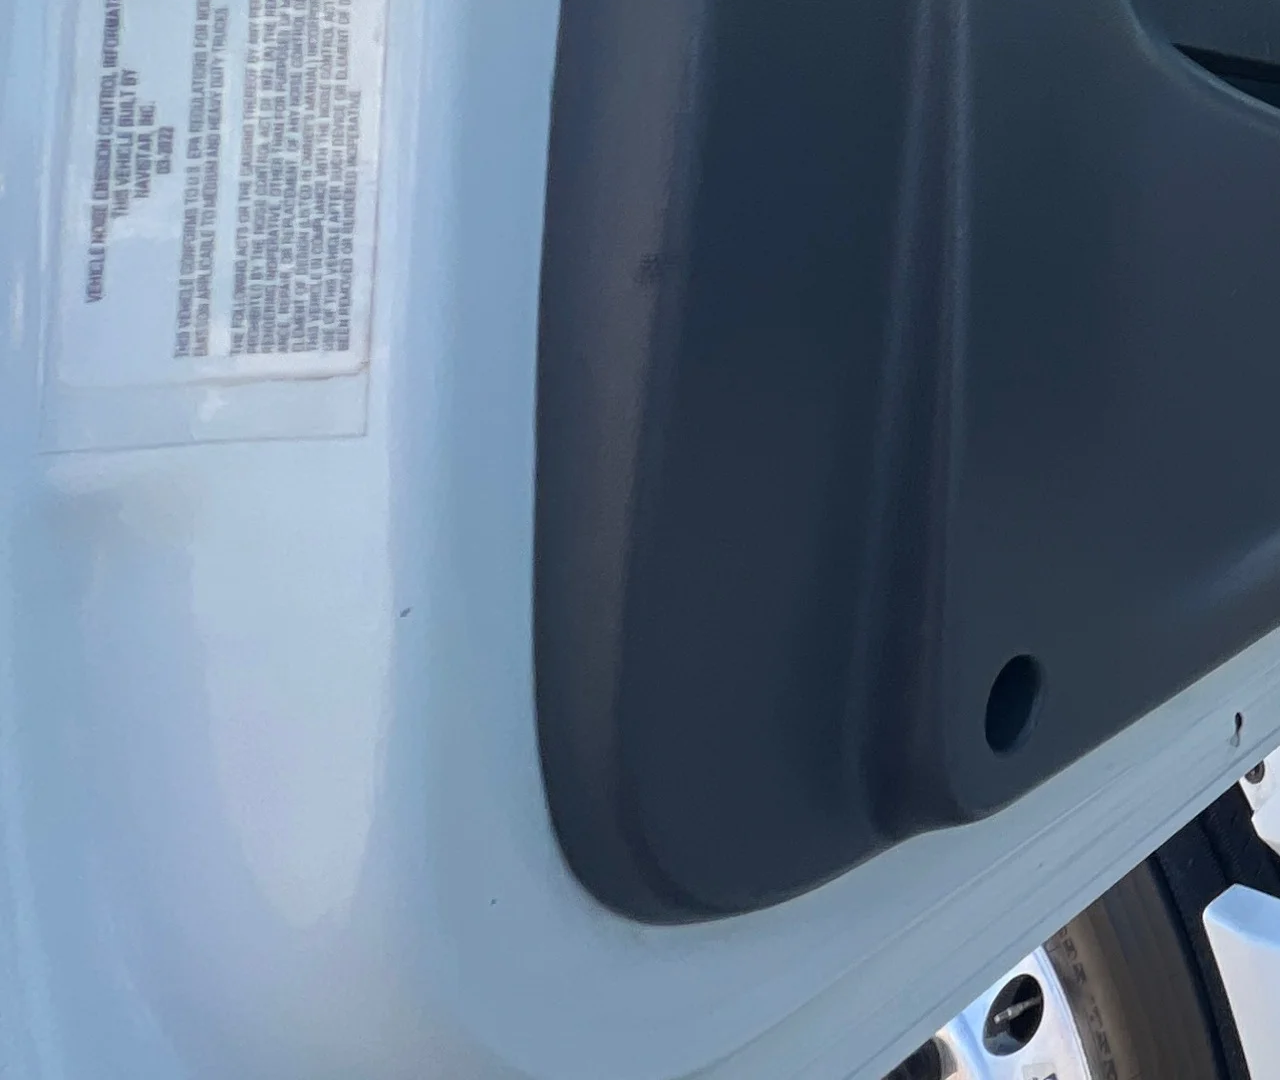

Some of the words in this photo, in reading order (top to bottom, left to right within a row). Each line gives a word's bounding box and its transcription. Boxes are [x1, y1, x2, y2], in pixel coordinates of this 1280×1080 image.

[193, 24, 209, 48] FOR
[120, 69, 139, 86] BY
[187, 52, 207, 132] REGULATIONS
[210, 58, 226, 88] DUTY
[96, 72, 117, 135] CONTROL
[117, 90, 136, 127] BUILT
[206, 91, 223, 130] HEAVY
[92, 139, 111, 200] EMISSION
[112, 131, 133, 186] VEHICLE
[110, 190, 129, 219] THIS
[201, 161, 217, 207] MEDIUM
[88, 206, 108, 244] NOISE
[179, 208, 197, 276] CONFORMS
[235, 228, 249, 256] ACTS
[86, 248, 105, 304] VEHICLE
[195, 229, 215, 299] APPLICABLE
[176, 279, 193, 329] VEHICLE
[231, 260, 247, 328] FOLLOWING
[174, 332, 190, 358] THIS
